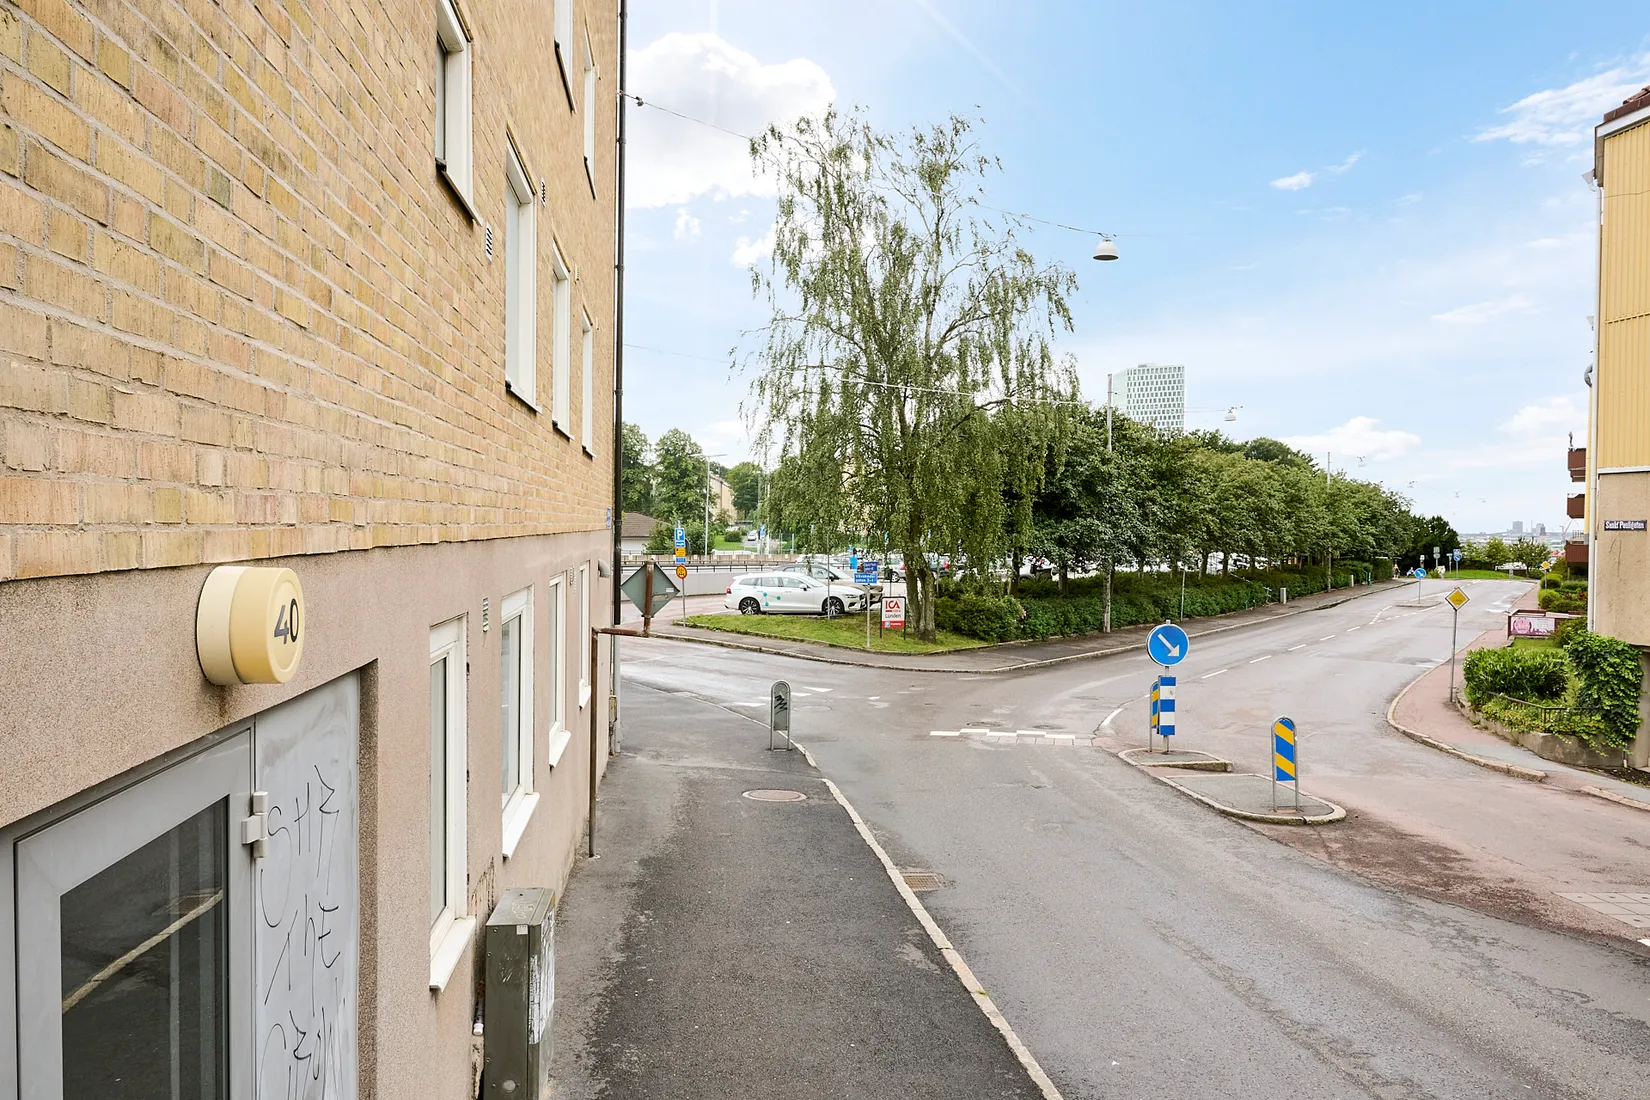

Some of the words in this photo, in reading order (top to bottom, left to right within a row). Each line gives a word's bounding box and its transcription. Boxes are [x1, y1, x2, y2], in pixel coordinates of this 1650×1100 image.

[677, 529, 683, 540] P
[885, 600, 901, 609] ICA
[274, 598, 299, 645] 40
